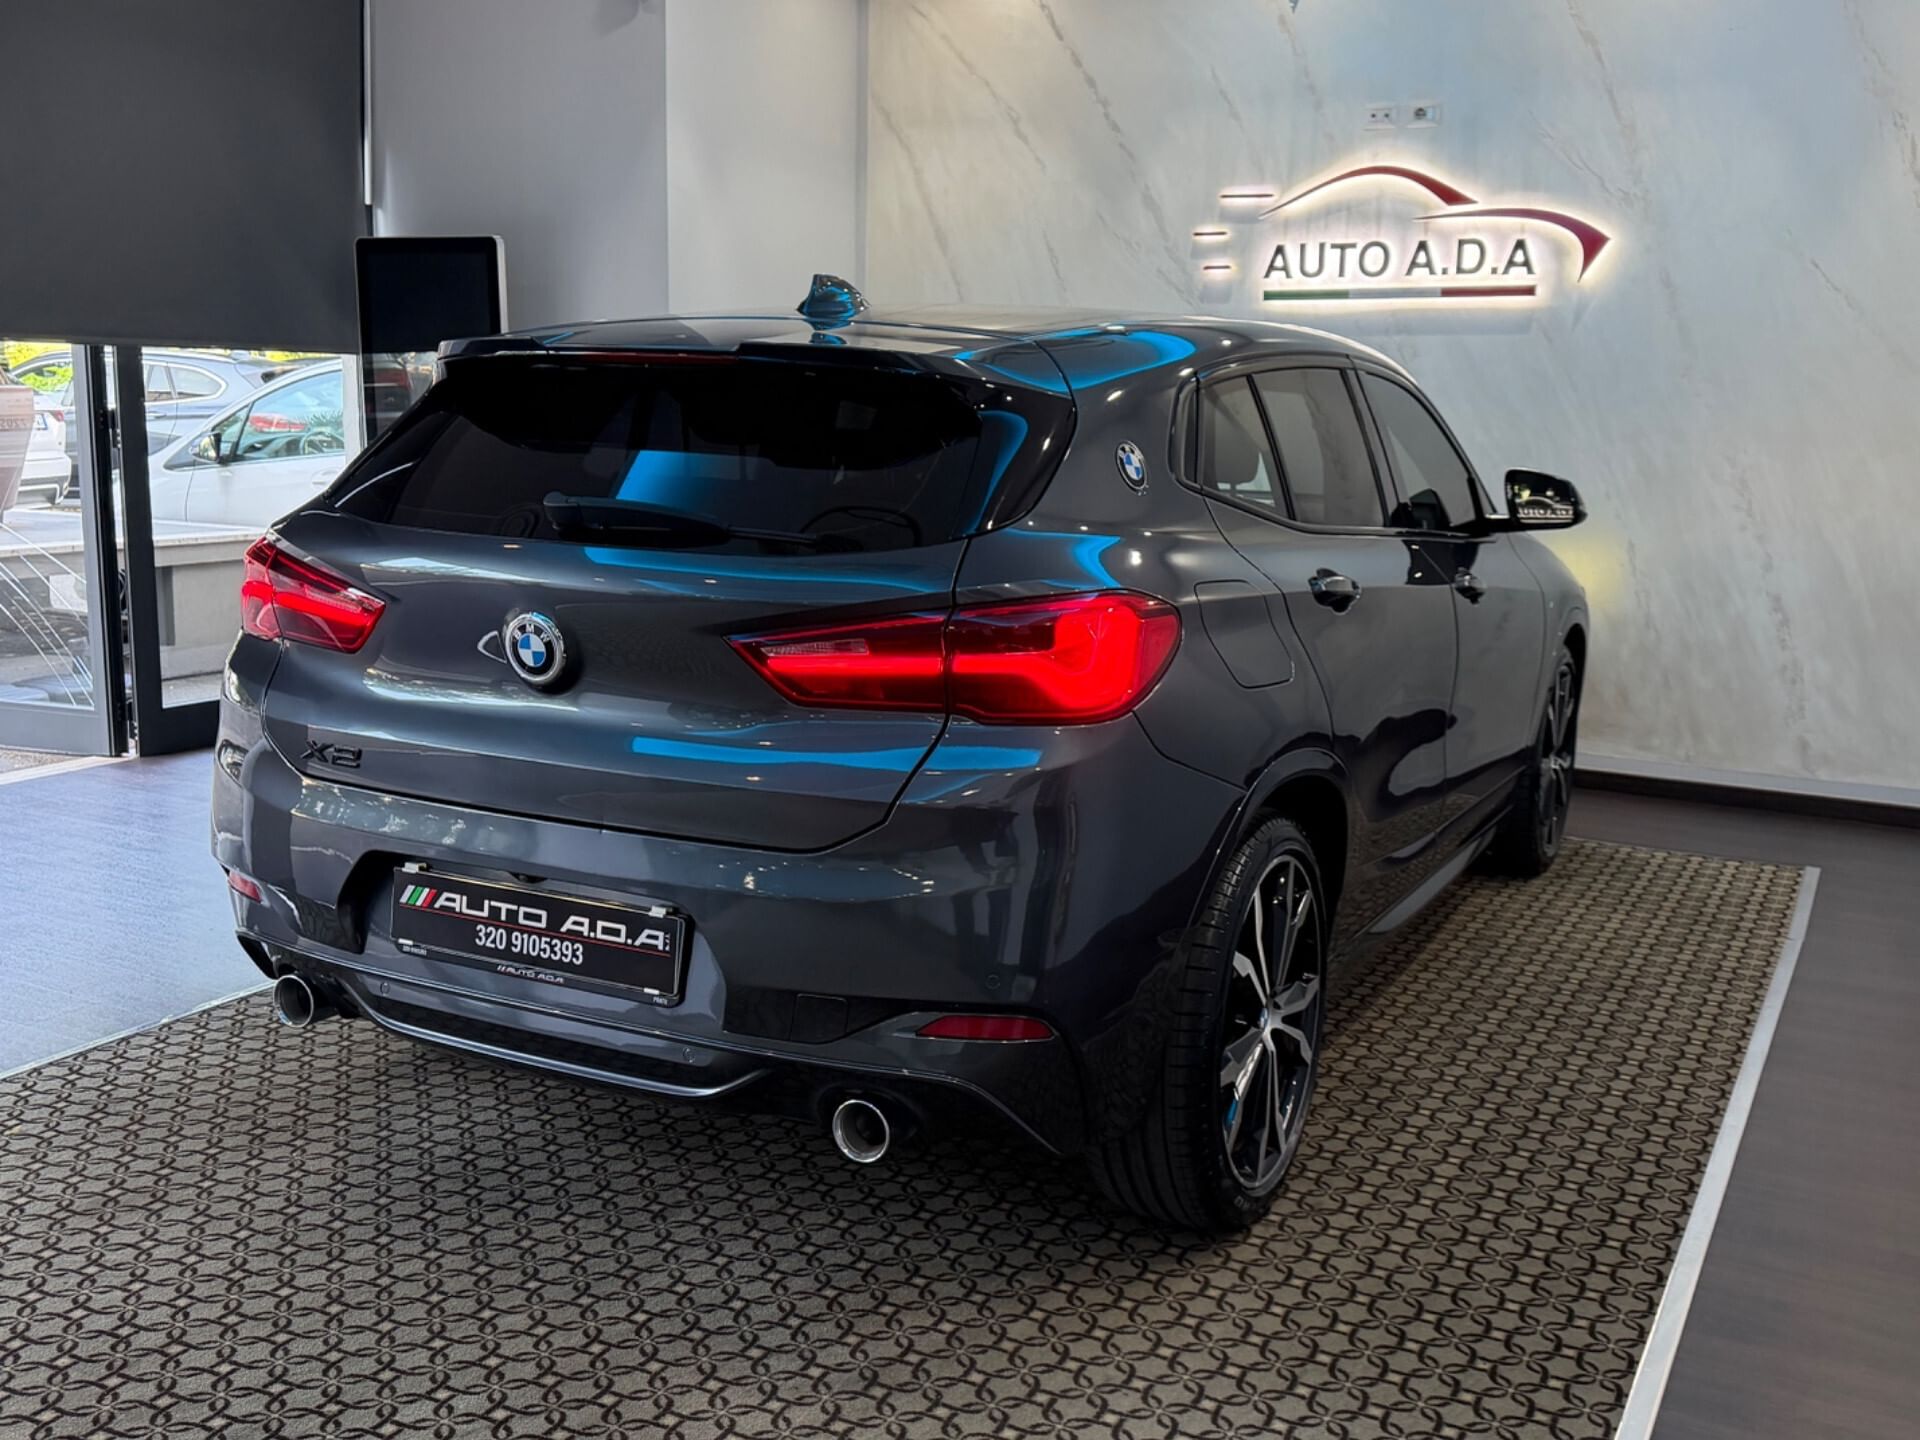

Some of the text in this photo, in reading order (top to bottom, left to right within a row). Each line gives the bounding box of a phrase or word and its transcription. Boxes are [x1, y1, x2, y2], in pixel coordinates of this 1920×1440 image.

[1263, 238, 1536, 279] AUTO A.D.A
[511, 622, 552, 643] BMW
[300, 739, 363, 768] X2
[433, 891, 548, 929] AUTO
[560, 914, 665, 951] A.D.A
[475, 924, 584, 966] 320 9105393
